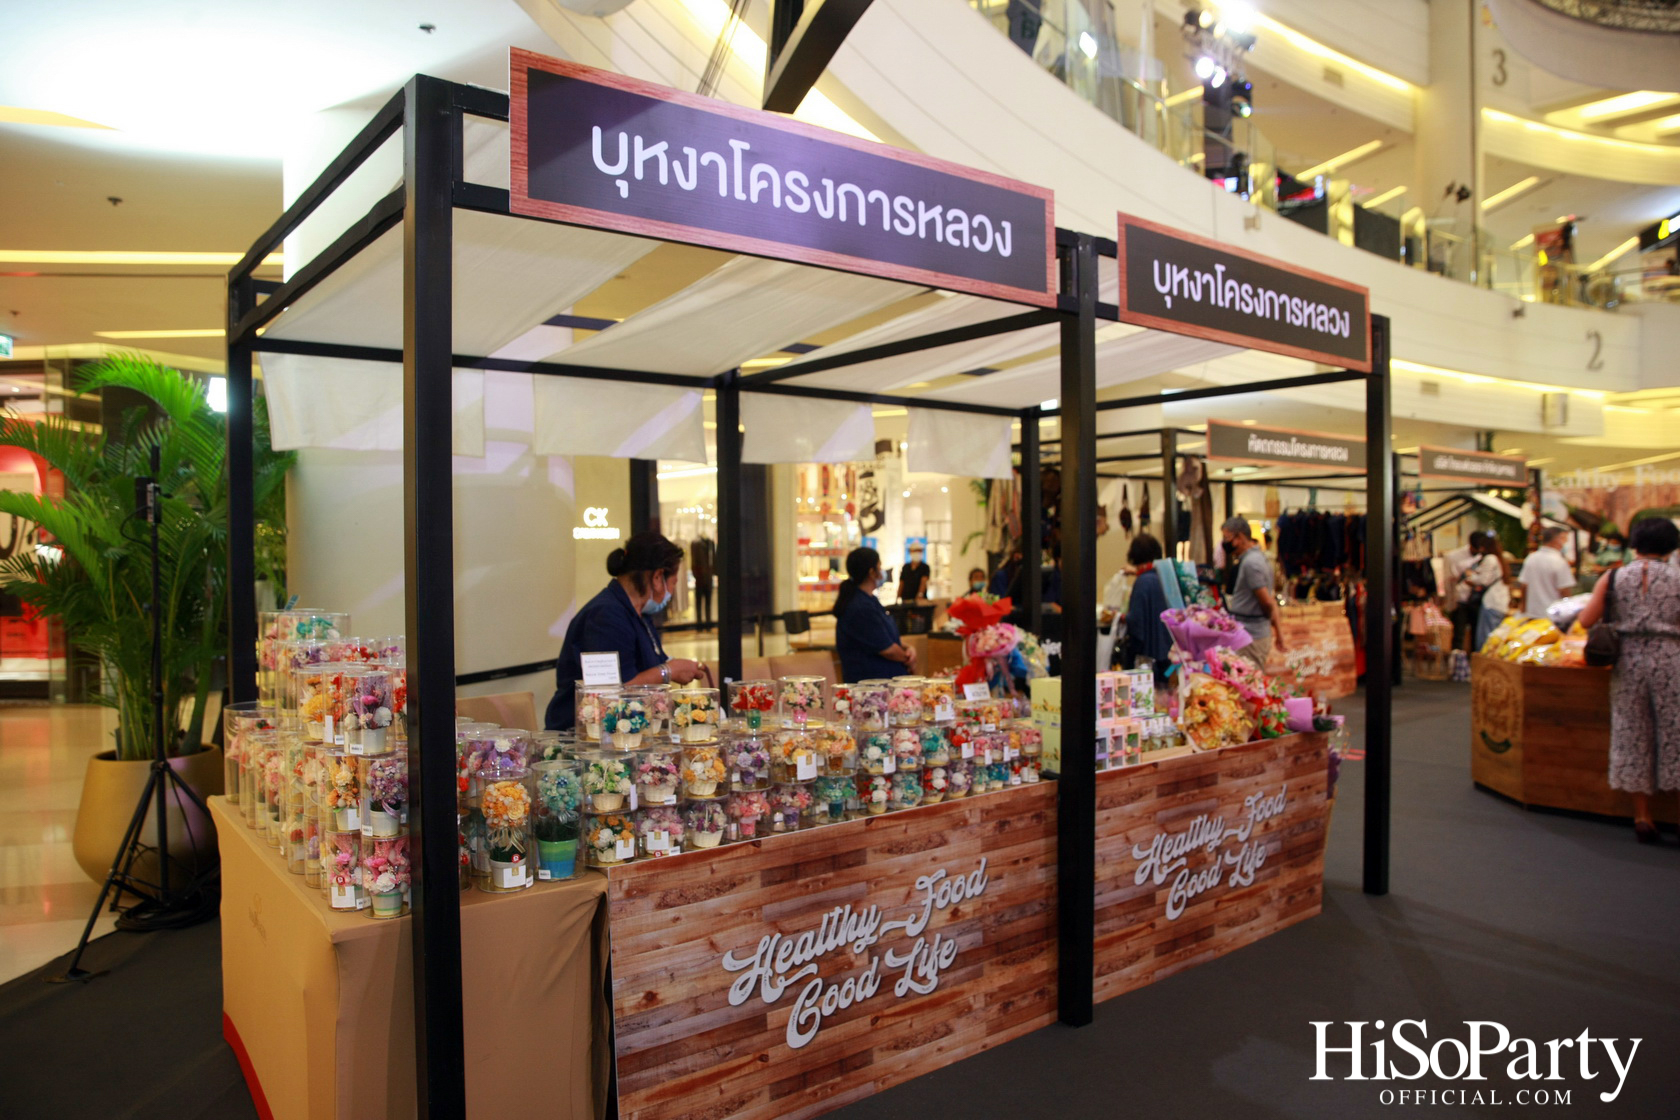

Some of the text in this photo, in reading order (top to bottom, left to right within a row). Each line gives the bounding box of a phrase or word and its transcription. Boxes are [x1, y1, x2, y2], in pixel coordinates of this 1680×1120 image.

[1492, 48, 1507, 86] 3
[592, 125, 1012, 257] บุหงาโครงการหลวง
[1153, 259, 1351, 339] บุหงาโครงการหลวง
[1586, 329, 1604, 371] 2
[1132, 784, 1288, 885] Healthy Food
[1166, 841, 1267, 920] Good Life
[722, 857, 989, 1006] Healthy Food
[786, 933, 957, 1049] Good Life
